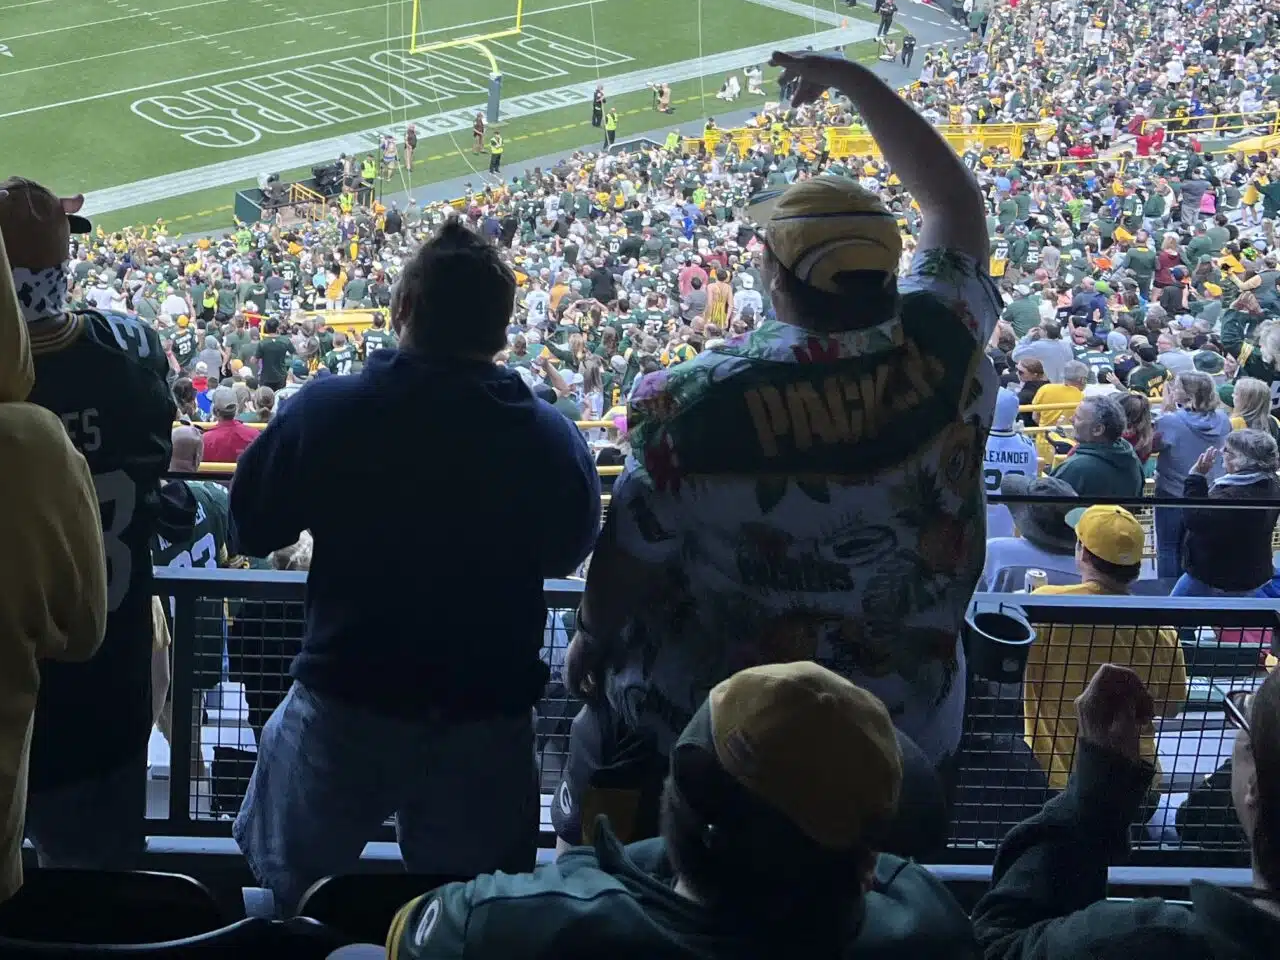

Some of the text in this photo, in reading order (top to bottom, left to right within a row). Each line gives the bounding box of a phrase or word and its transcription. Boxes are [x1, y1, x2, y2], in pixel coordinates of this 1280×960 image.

[130, 24, 636, 149] PACKERS
[510, 87, 588, 111] END
[984, 450, 1029, 464] LEXANDER
